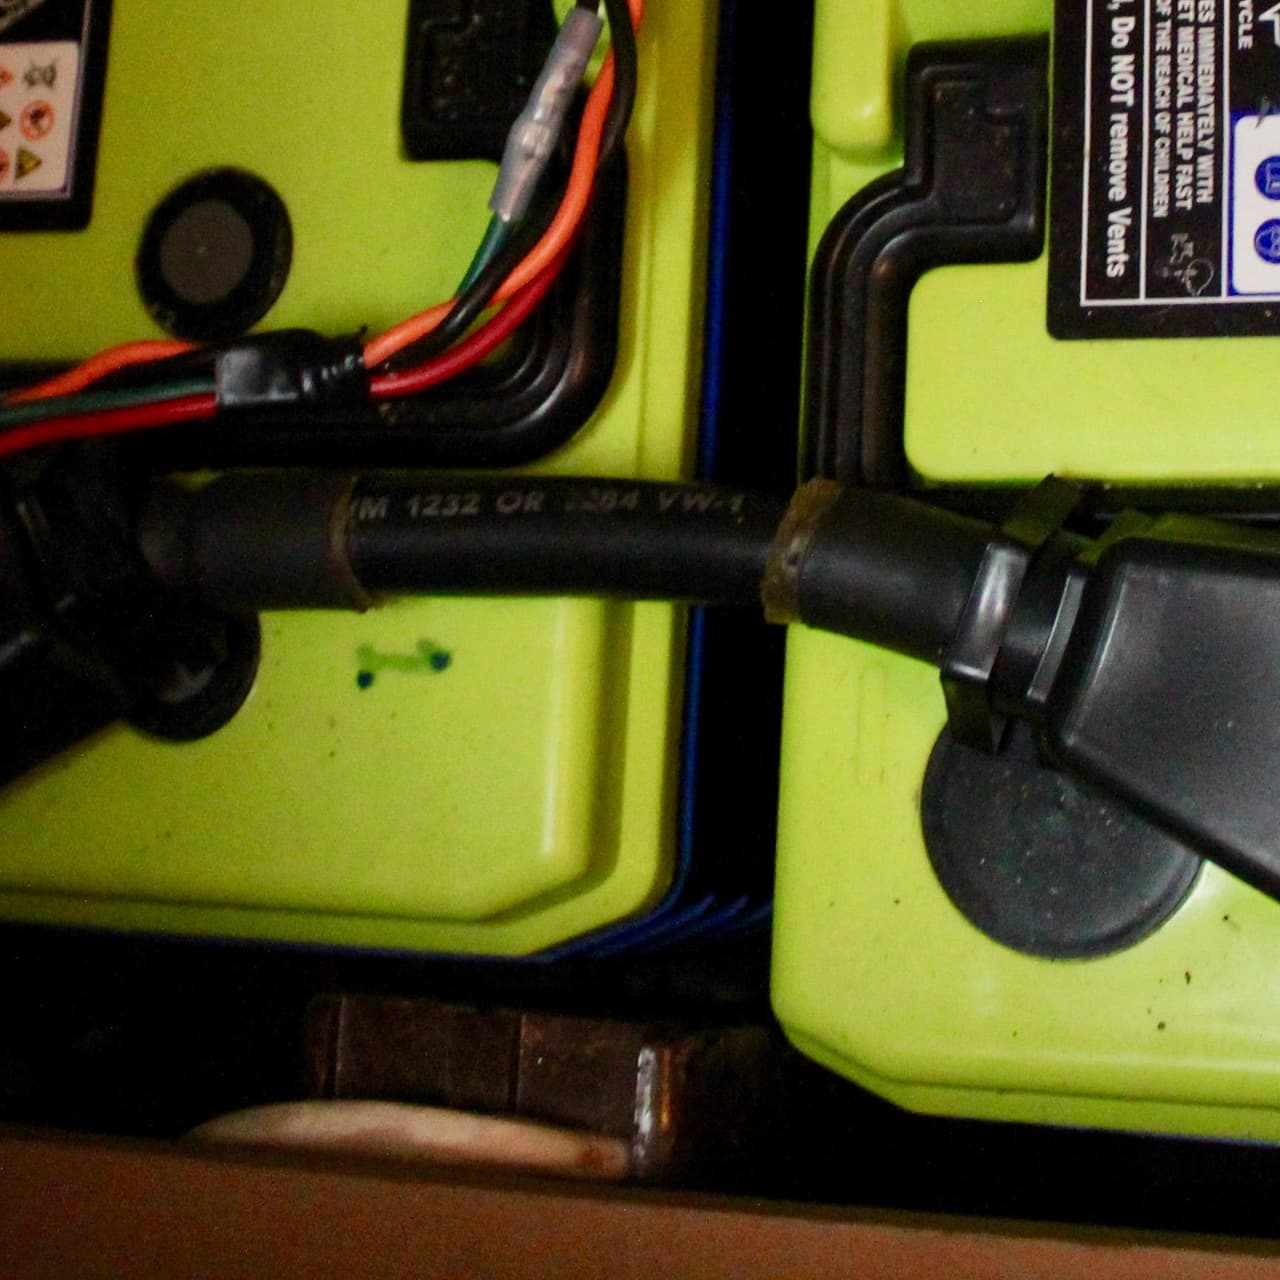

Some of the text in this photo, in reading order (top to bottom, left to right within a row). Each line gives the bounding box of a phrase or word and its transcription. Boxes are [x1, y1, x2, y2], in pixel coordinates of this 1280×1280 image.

[1111, 17, 1134, 49] Do
[1153, 21, 1171, 51] THE
[1110, 55, 1134, 105] NOT
[1153, 56, 1171, 109] REACH
[1176, 26, 1195, 108] MEDICAL
[1196, 28, 1215, 149] IMMEDIATELY
[1153, 114, 1171, 134] OF
[1176, 112, 1195, 160] HELP
[1107, 113, 1130, 201] remove
[1153, 138, 1171, 218] CHILDREN
[1196, 154, 1215, 203] WITH
[1176, 164, 1195, 210] FAST
[1107, 208, 1131, 277] Vents
